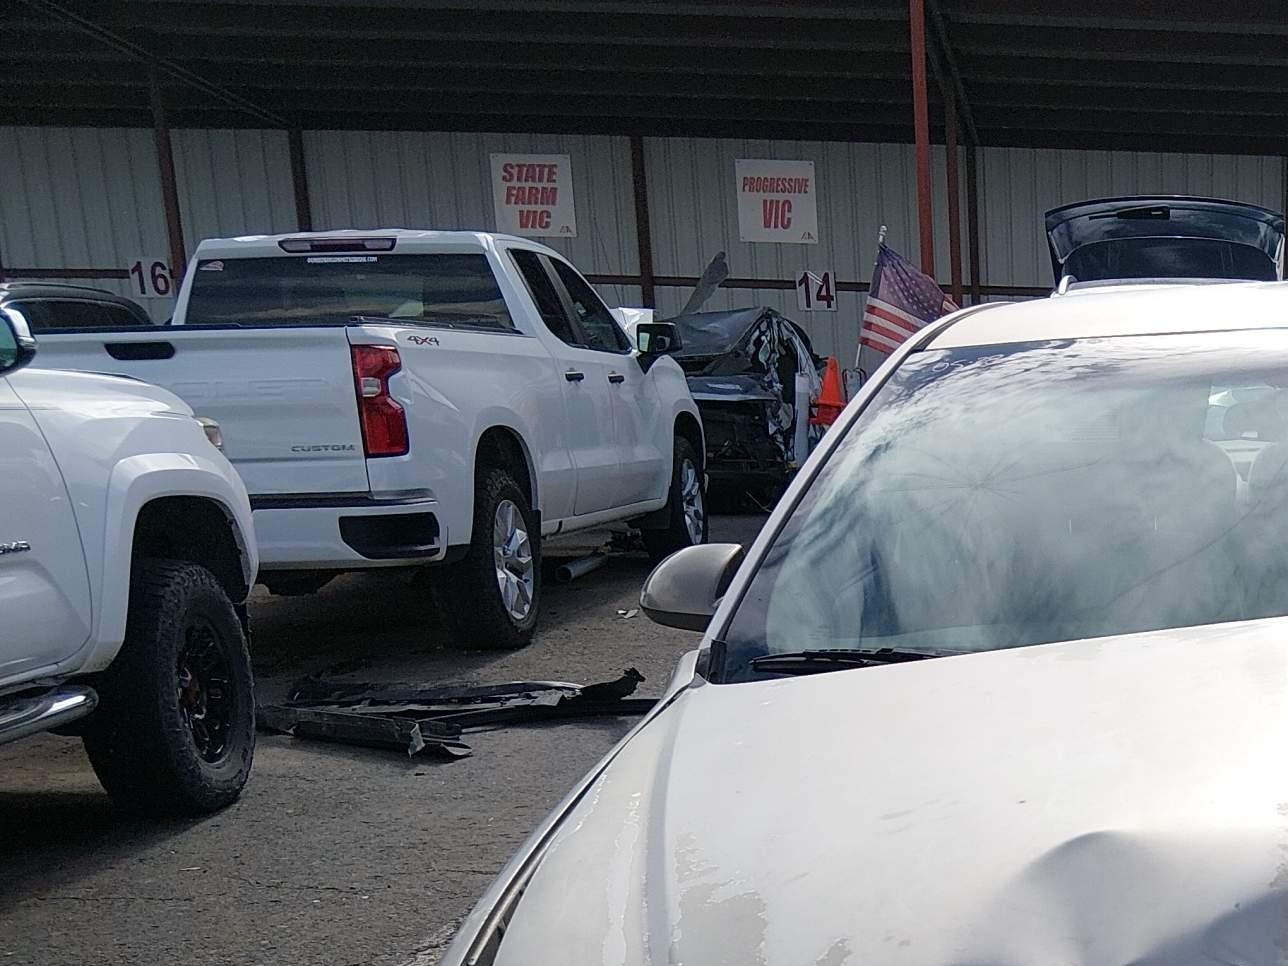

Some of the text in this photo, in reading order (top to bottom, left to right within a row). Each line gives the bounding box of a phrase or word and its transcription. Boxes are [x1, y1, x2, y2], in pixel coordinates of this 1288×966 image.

[502, 163, 558, 183] STATE
[742, 176, 809, 194] PROGRESSIVE
[505, 186, 558, 206] FARM
[519, 209, 552, 230] VIC
[763, 199, 792, 230] VIC
[131, 261, 170, 295] 16
[798, 271, 835, 309] 14
[291, 444, 356, 453] CUSTOM
